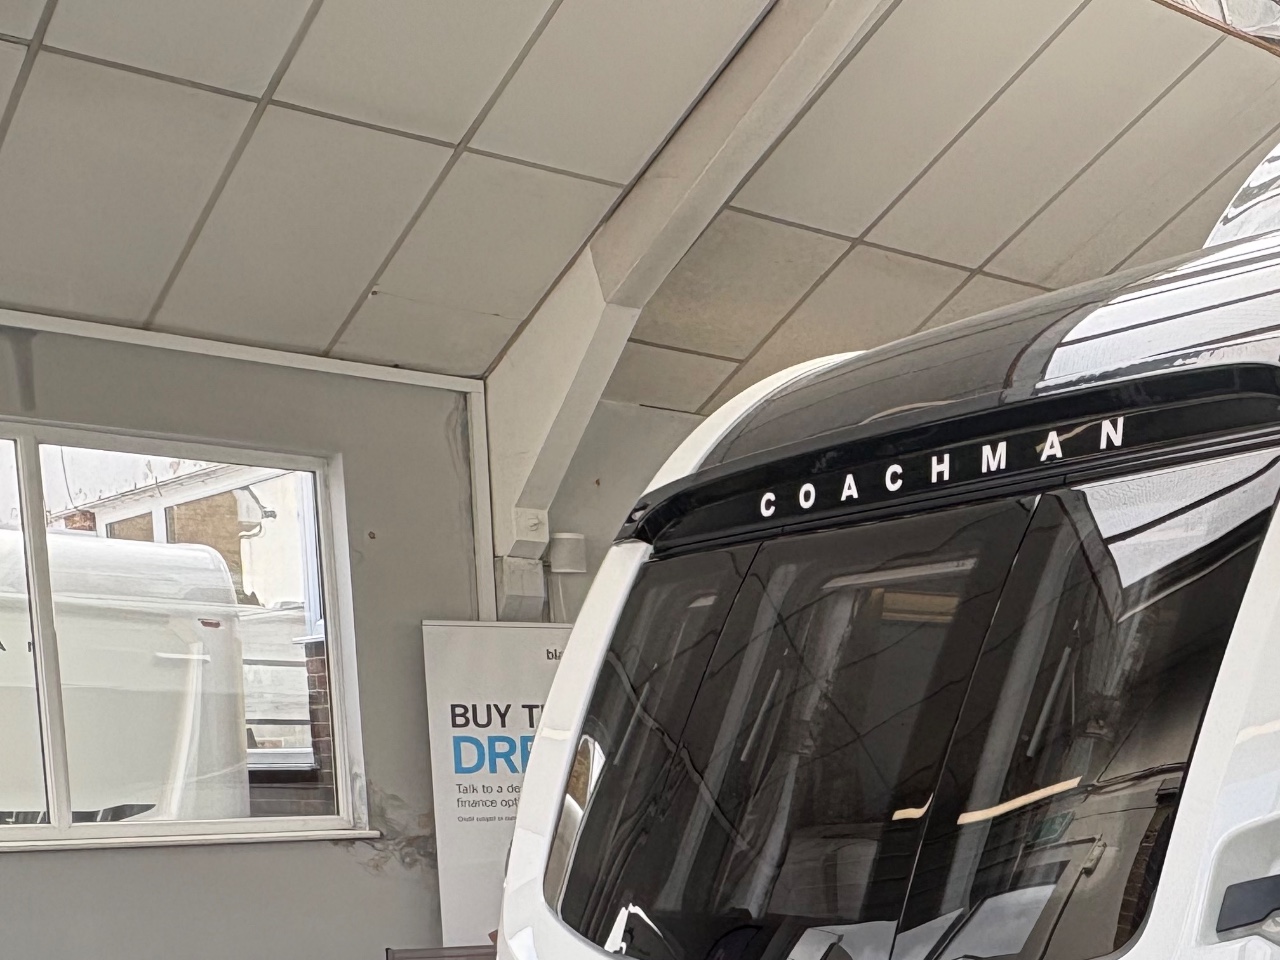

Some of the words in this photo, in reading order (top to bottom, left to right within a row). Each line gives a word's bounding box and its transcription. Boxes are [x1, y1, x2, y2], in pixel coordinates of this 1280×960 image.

[760, 416, 1124, 517] COACHMAN
[450, 703, 512, 729] BUY
[521, 703, 546, 729] T
[456, 783, 479, 794] Talk
[482, 784, 493, 794] to
[496, 785, 503, 794] a
